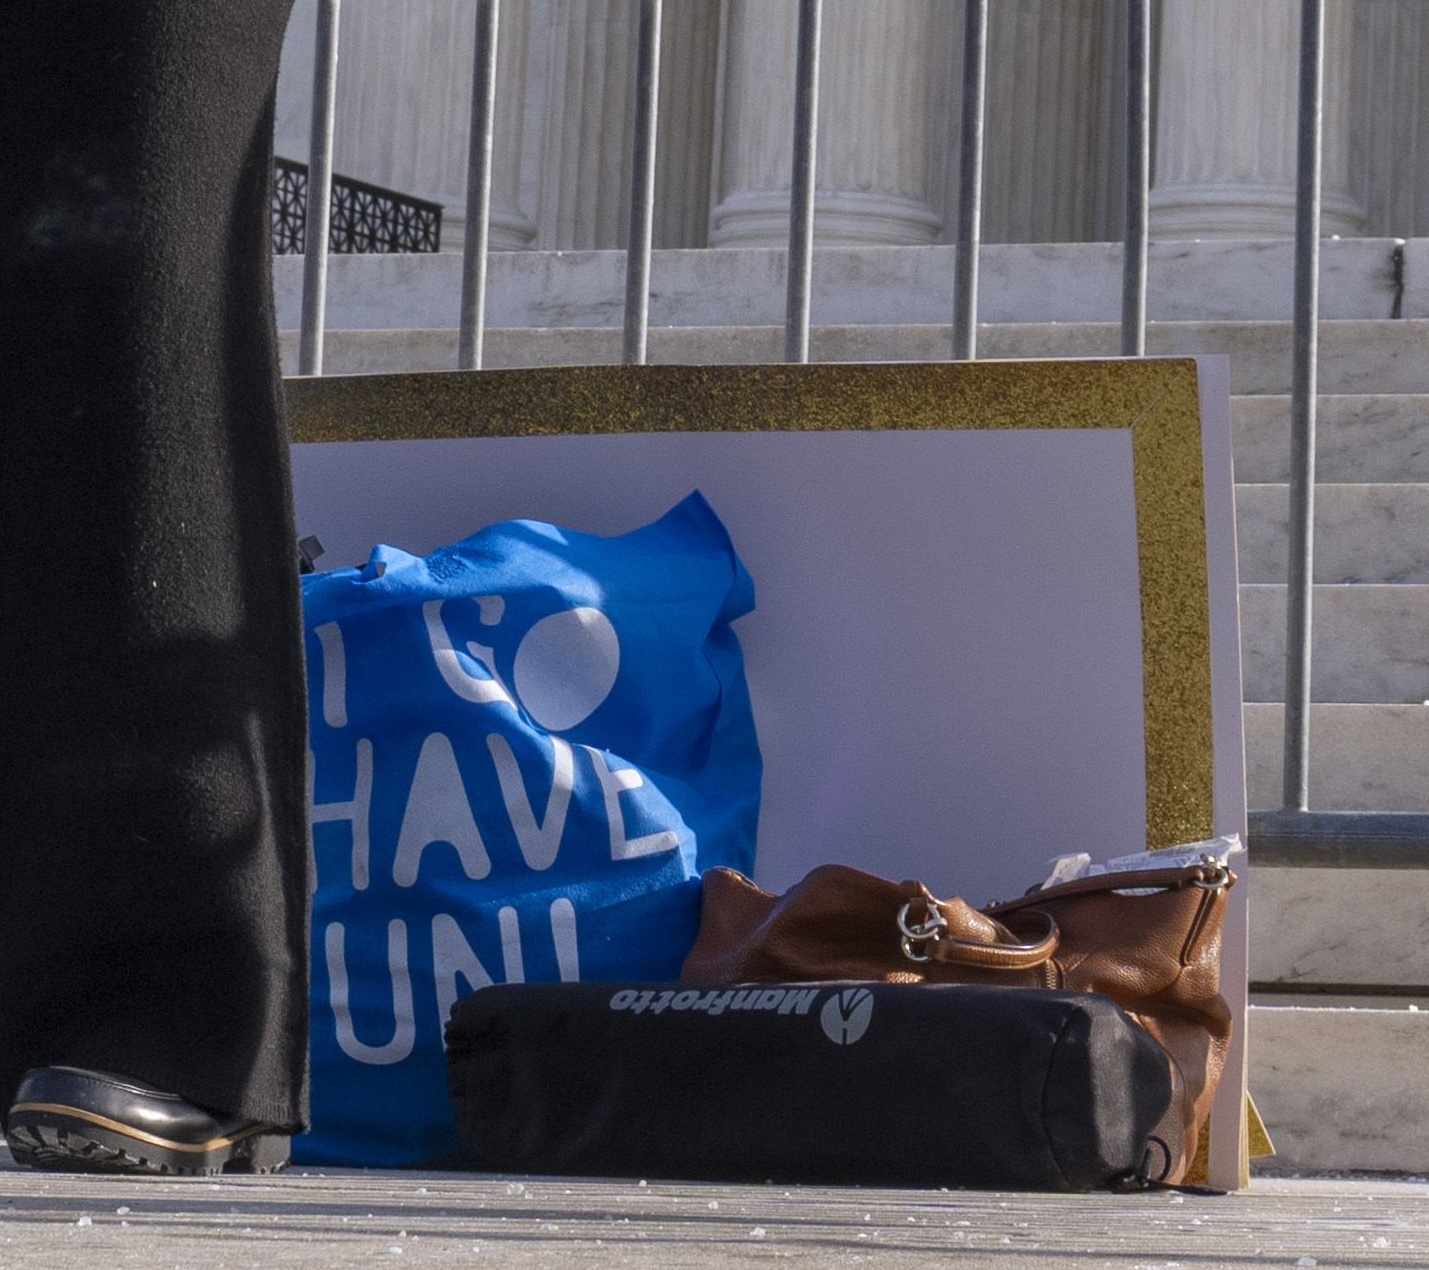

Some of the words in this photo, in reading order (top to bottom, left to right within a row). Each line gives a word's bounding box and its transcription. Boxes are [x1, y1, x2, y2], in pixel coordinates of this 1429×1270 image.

[314, 620, 349, 729] I
[309, 732, 680, 896] HAVE
[609, 988, 821, 1016] Manfrotto
